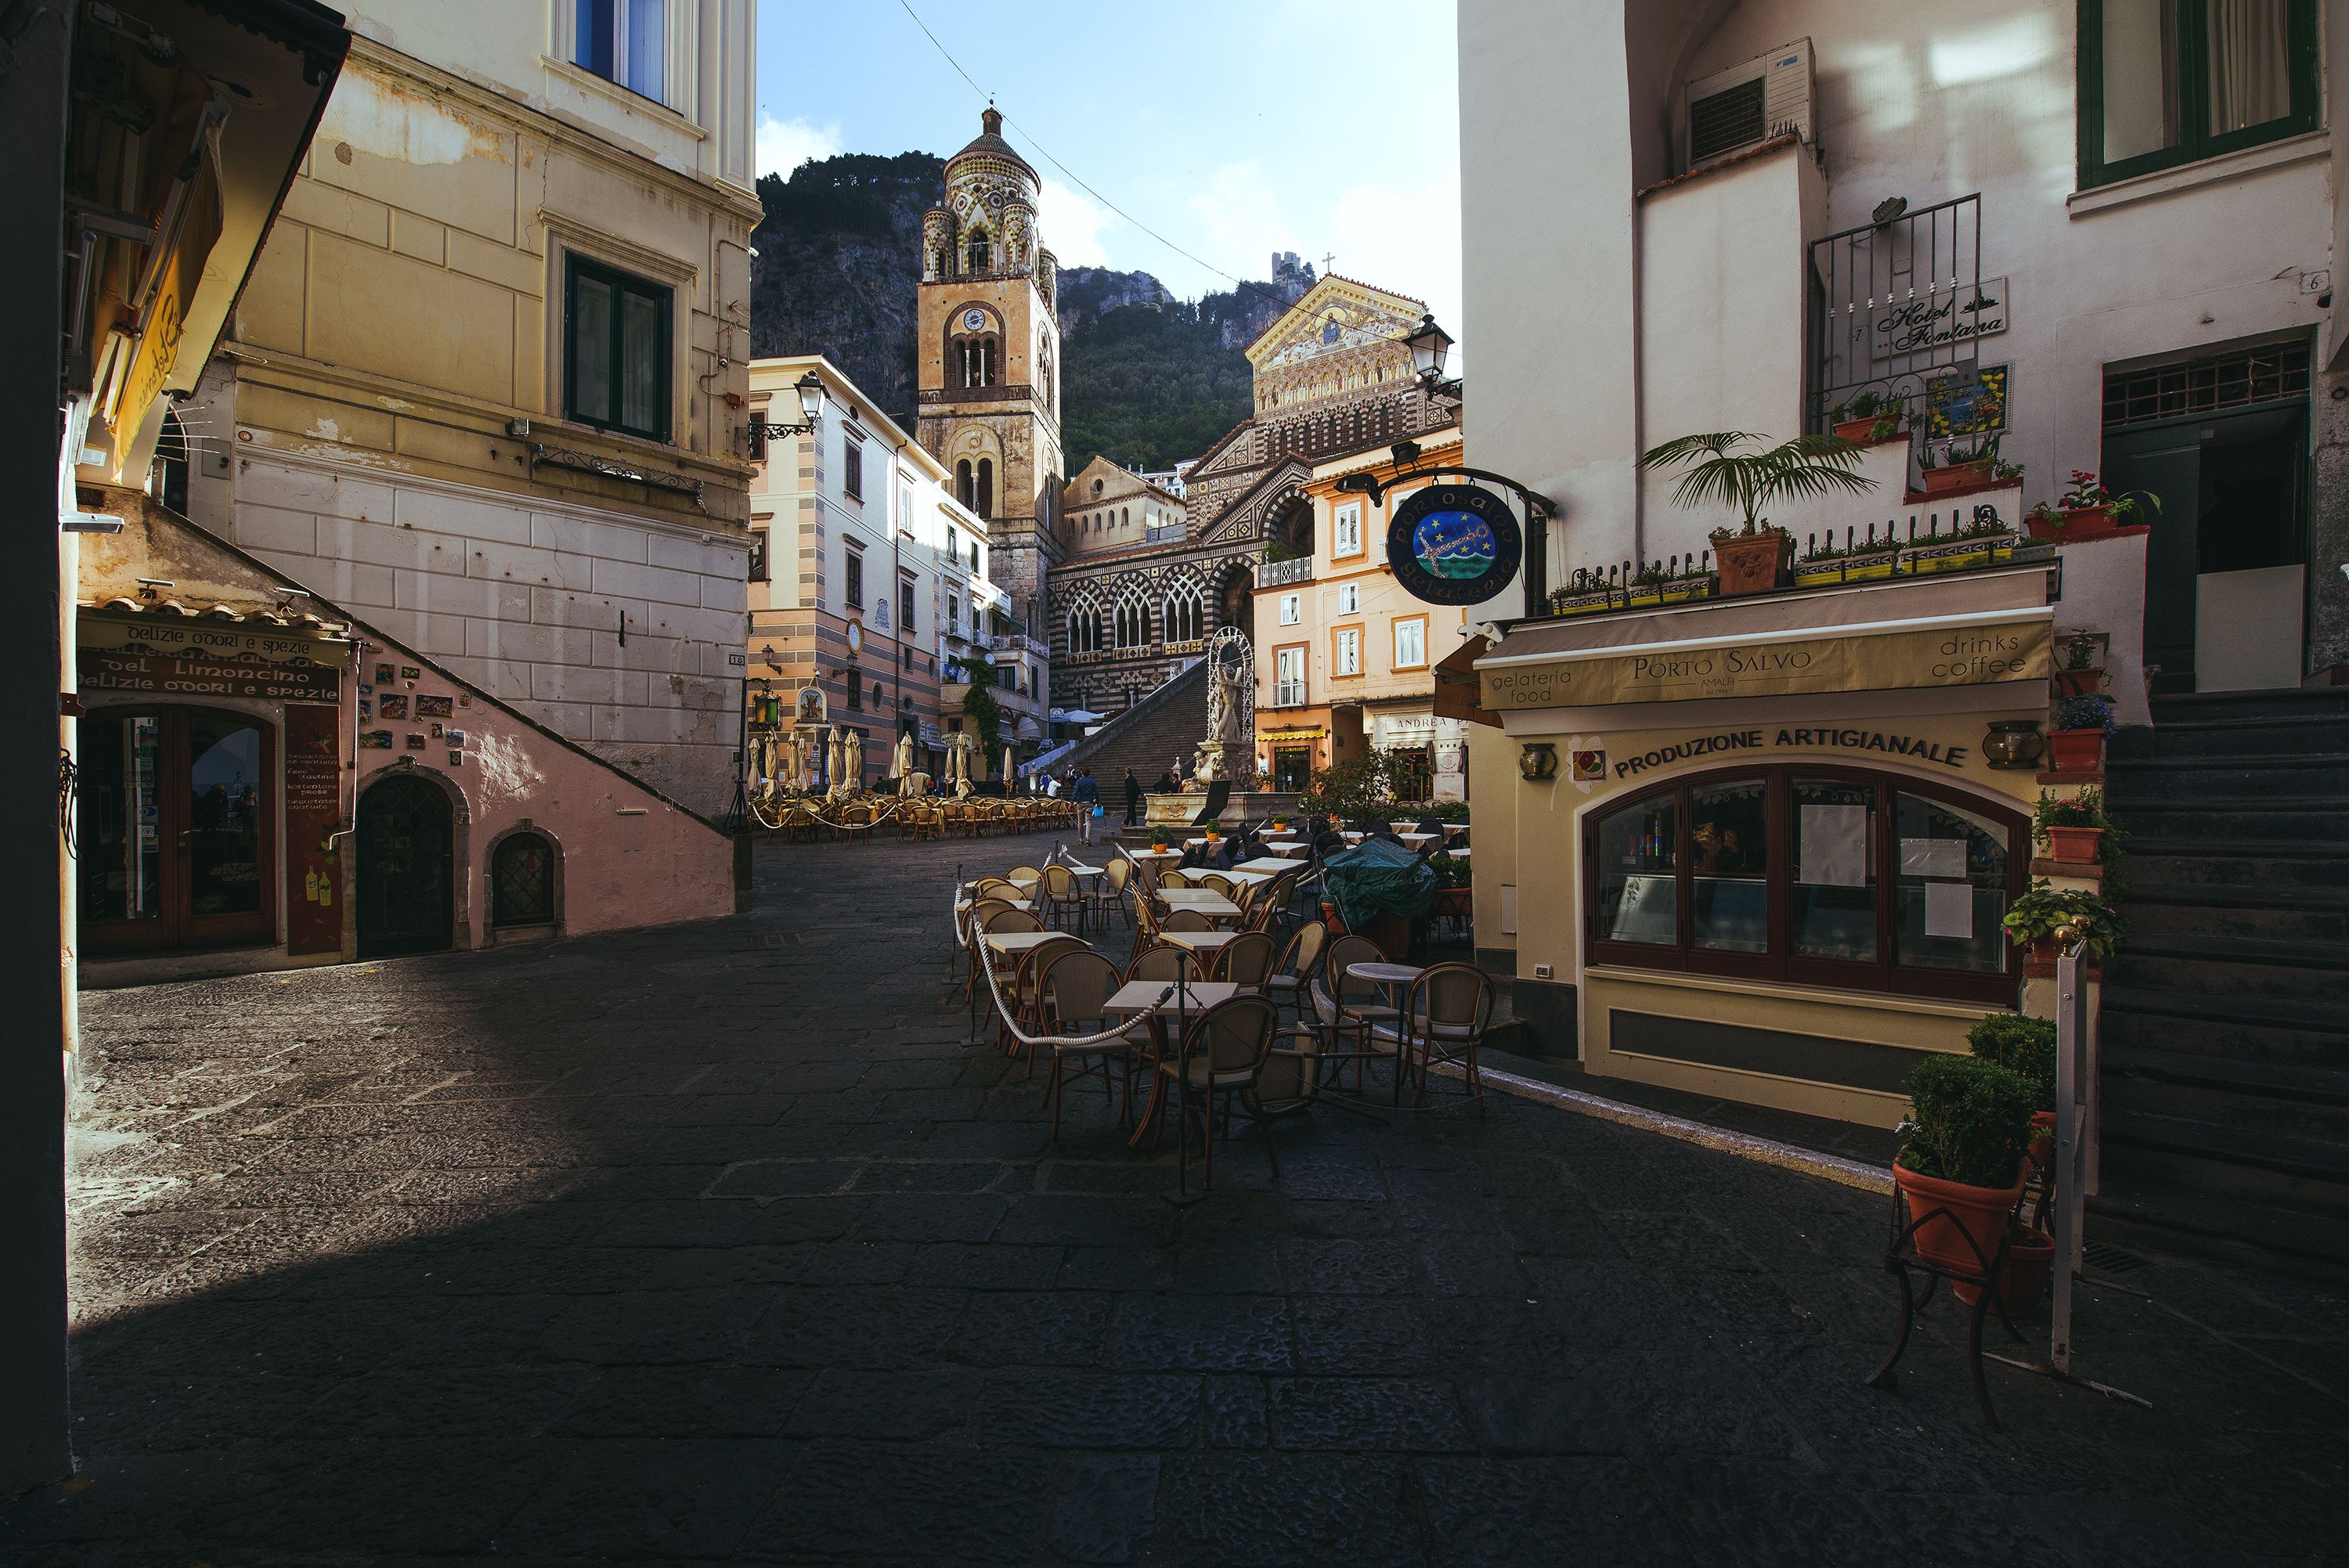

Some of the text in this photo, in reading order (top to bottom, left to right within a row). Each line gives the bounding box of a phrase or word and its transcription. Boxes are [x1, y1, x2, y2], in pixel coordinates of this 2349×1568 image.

[2311, 274, 2318, 290] 6
[1877, 297, 1954, 332] Hotel
[1854, 329, 1863, 342] 7
[1895, 318, 2002, 351] Fontana
[1939, 634, 2019, 657] drinks
[1932, 655, 2026, 678] coffee
[1492, 670, 1571, 690] gelateria
[1701, 677, 1734, 687] AMALFI
[1510, 687, 1551, 704] food
[1397, 718, 1446, 729] ANDREA
[1614, 729, 1968, 779] PRODUZIONE ARTIGIANALE
